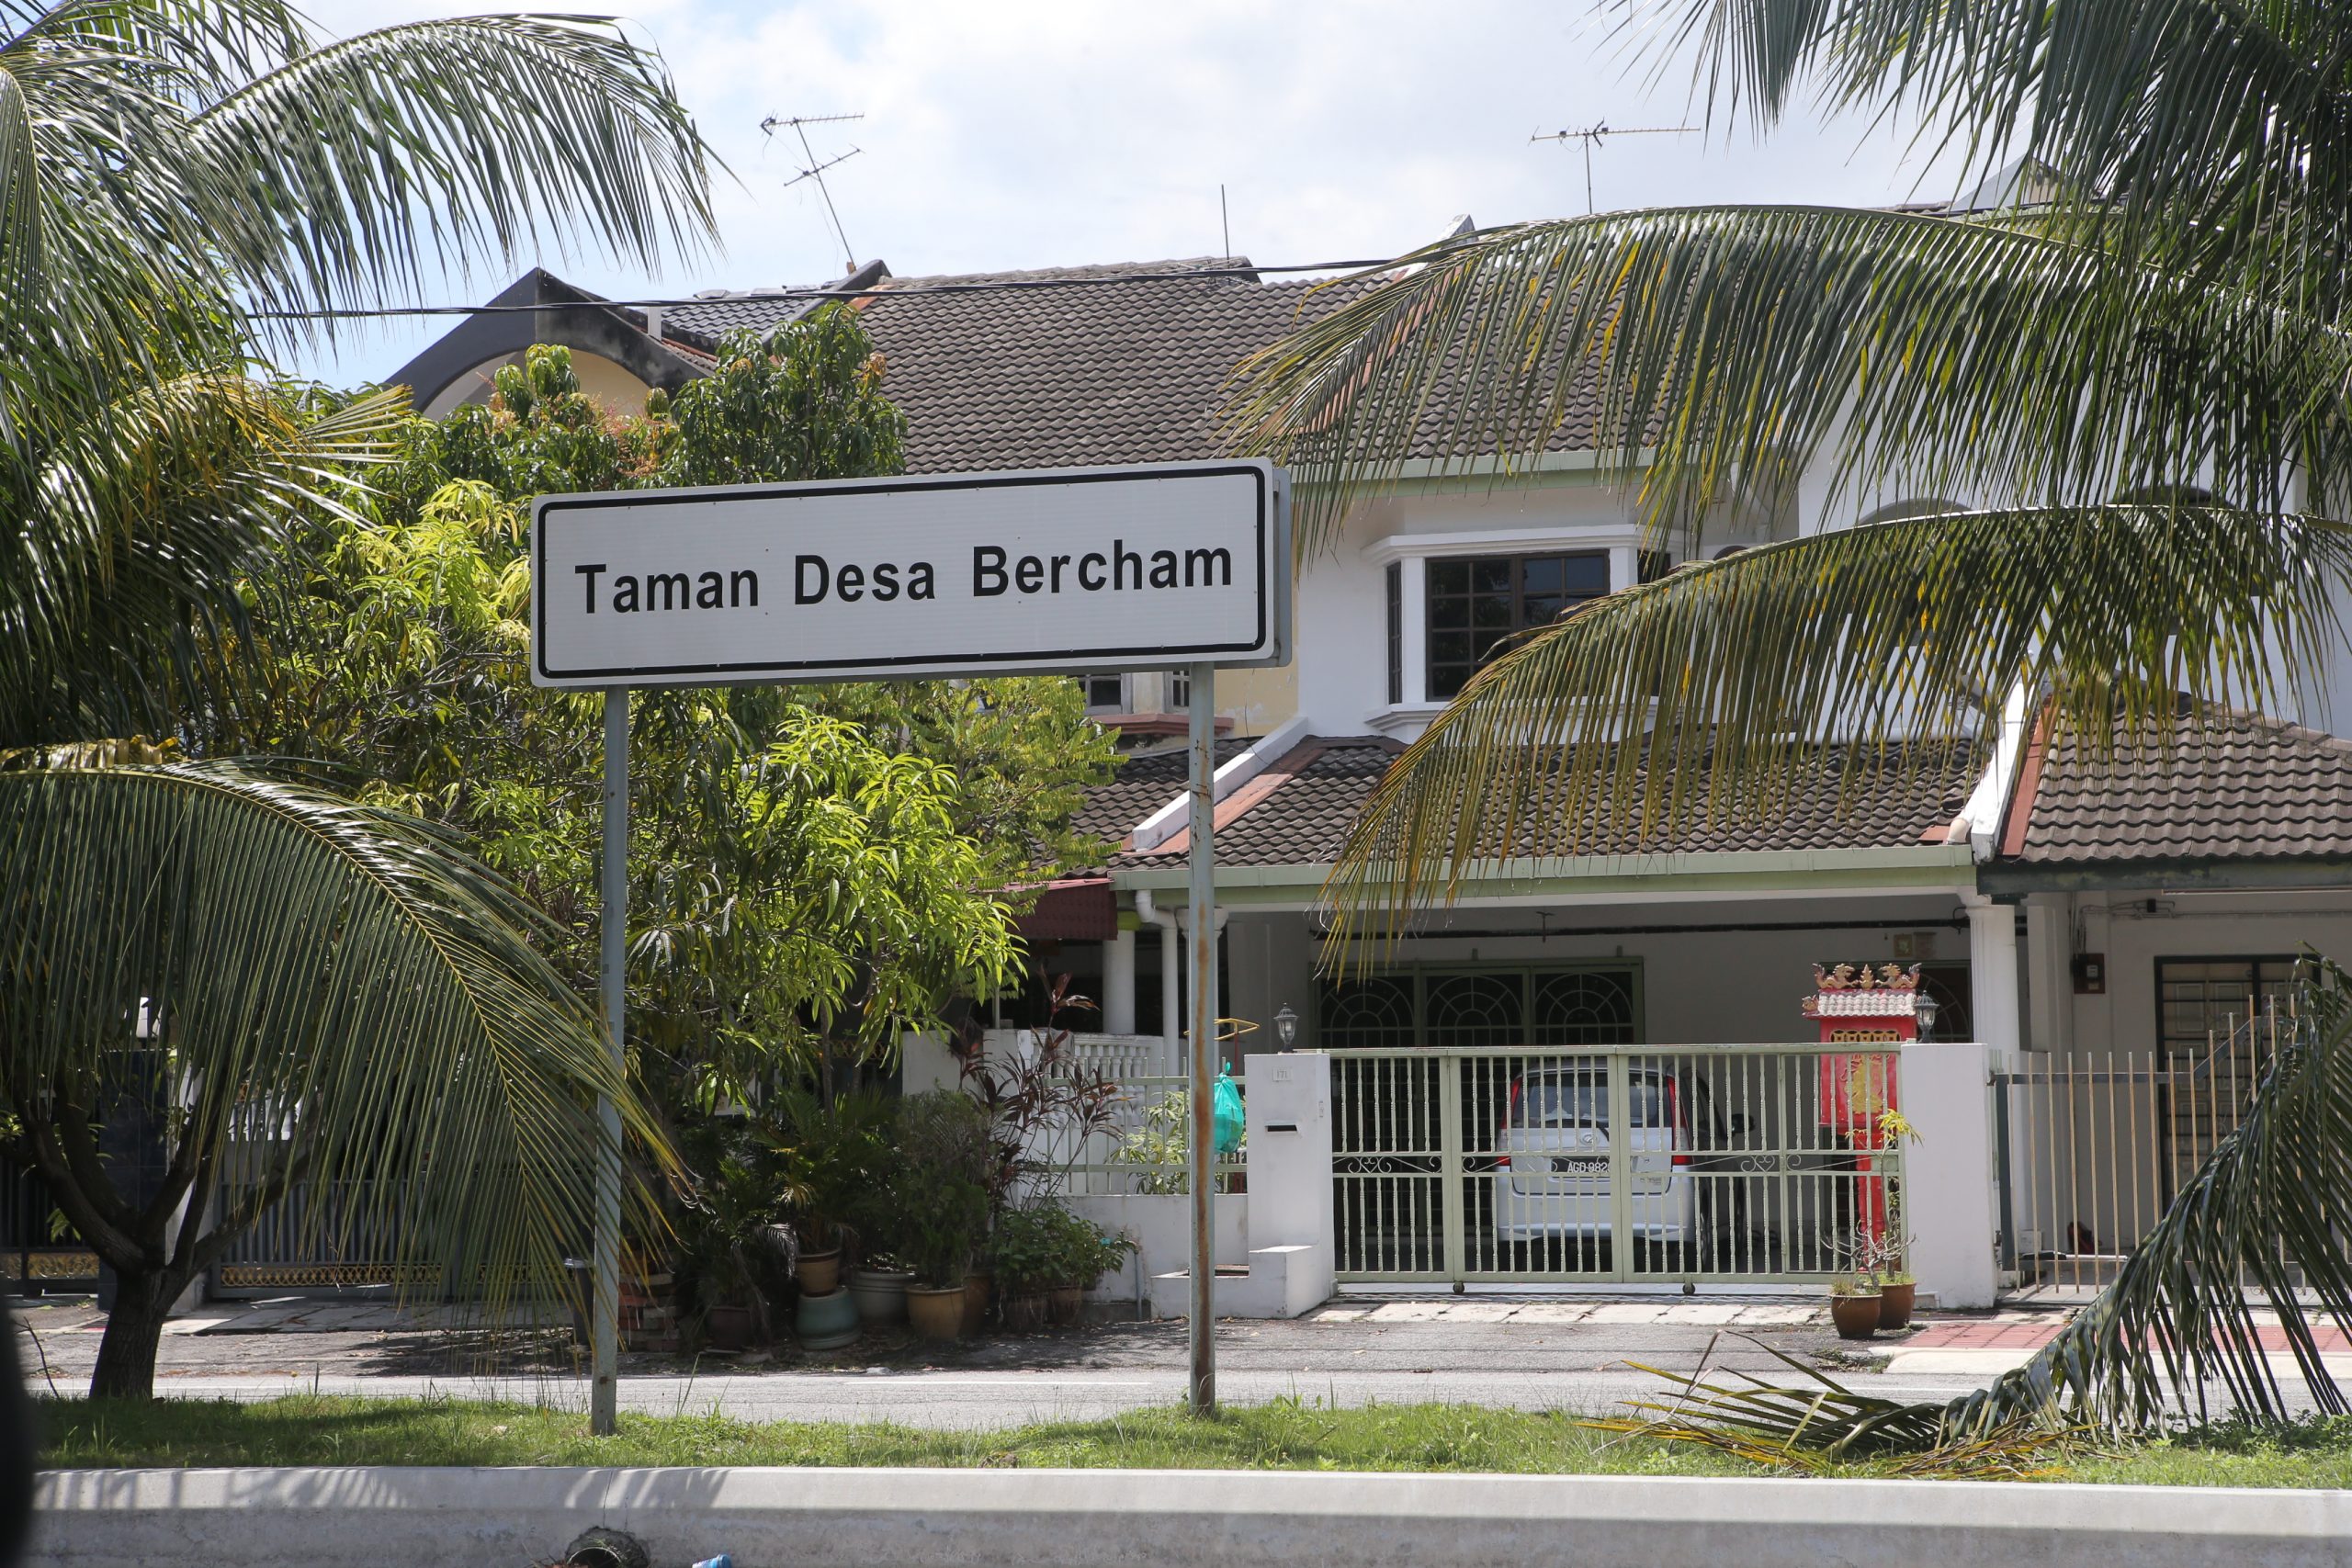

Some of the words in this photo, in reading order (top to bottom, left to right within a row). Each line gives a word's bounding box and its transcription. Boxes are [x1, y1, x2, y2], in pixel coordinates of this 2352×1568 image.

[574, 562, 760, 615] Taman
[794, 554, 936, 605] Desa
[973, 538, 1232, 597] Bercham
[1567, 1161, 1587, 1173] AGD
